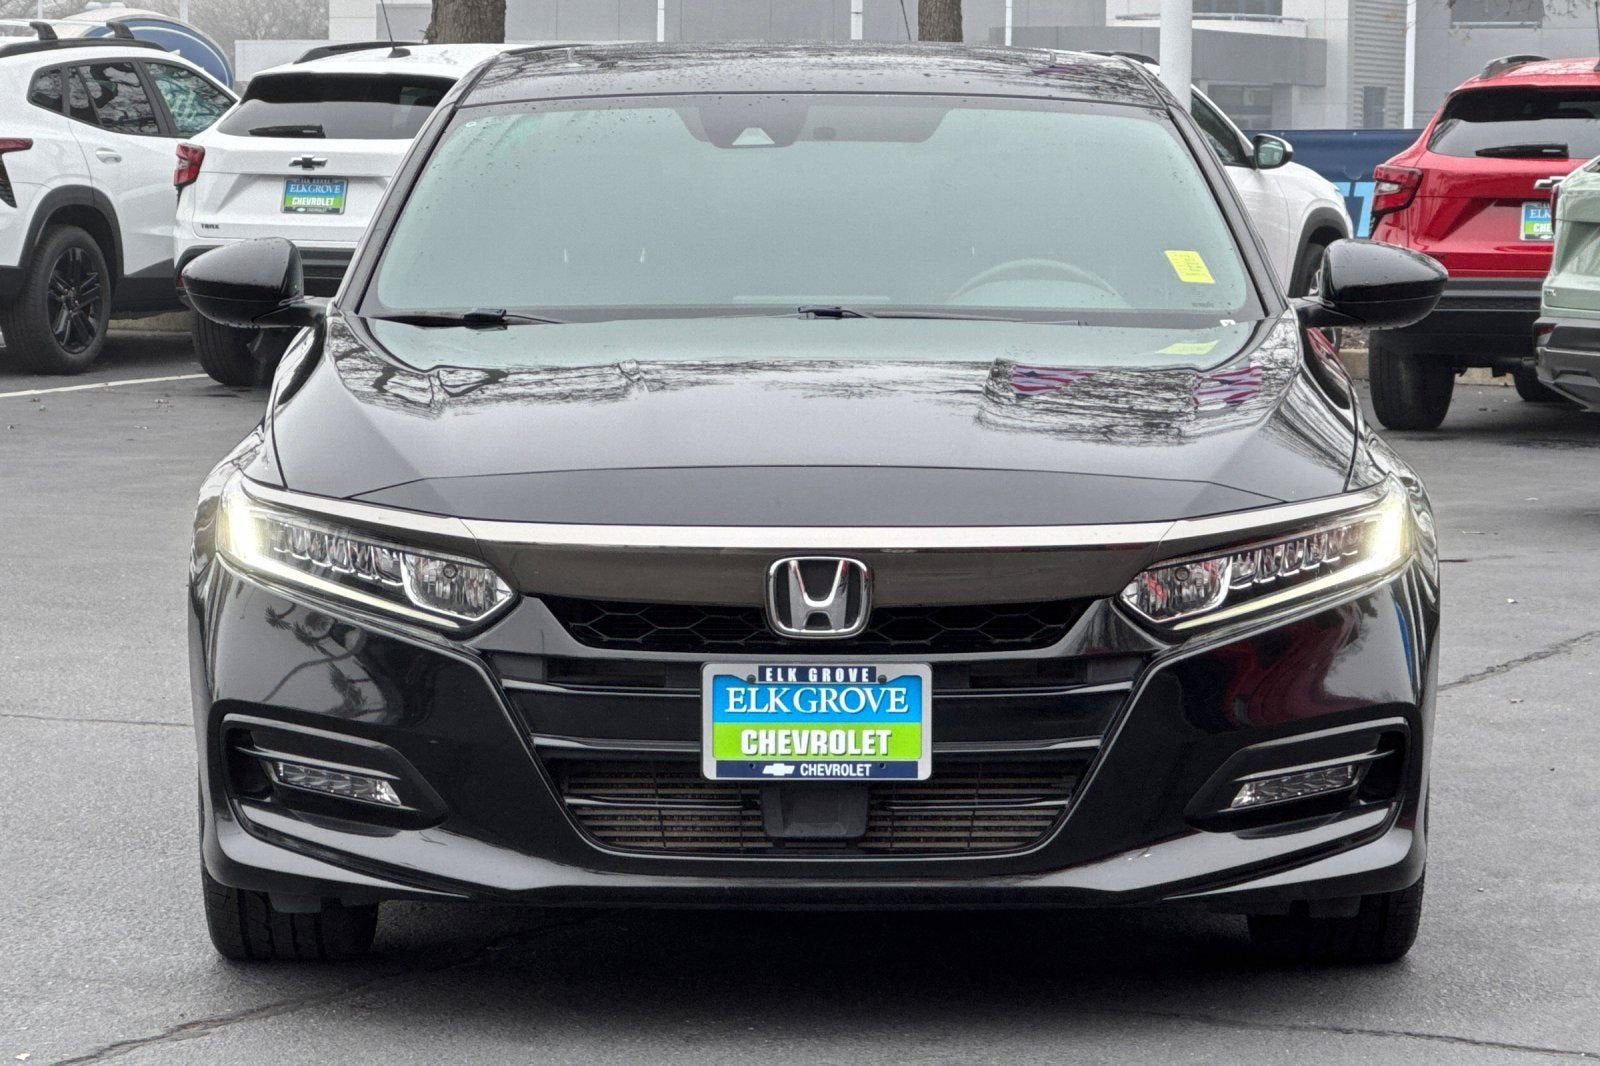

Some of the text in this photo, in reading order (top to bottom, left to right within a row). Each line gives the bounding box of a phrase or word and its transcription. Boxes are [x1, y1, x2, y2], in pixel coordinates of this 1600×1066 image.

[290, 183, 341, 194] ELK GROVE
[291, 197, 335, 206] CHEVROLET
[765, 667, 869, 682] ELK GROVE
[725, 687, 909, 713] ELK GROVE
[741, 729, 892, 755] CHEVROLET
[800, 763, 872, 777] CHEVROLET
